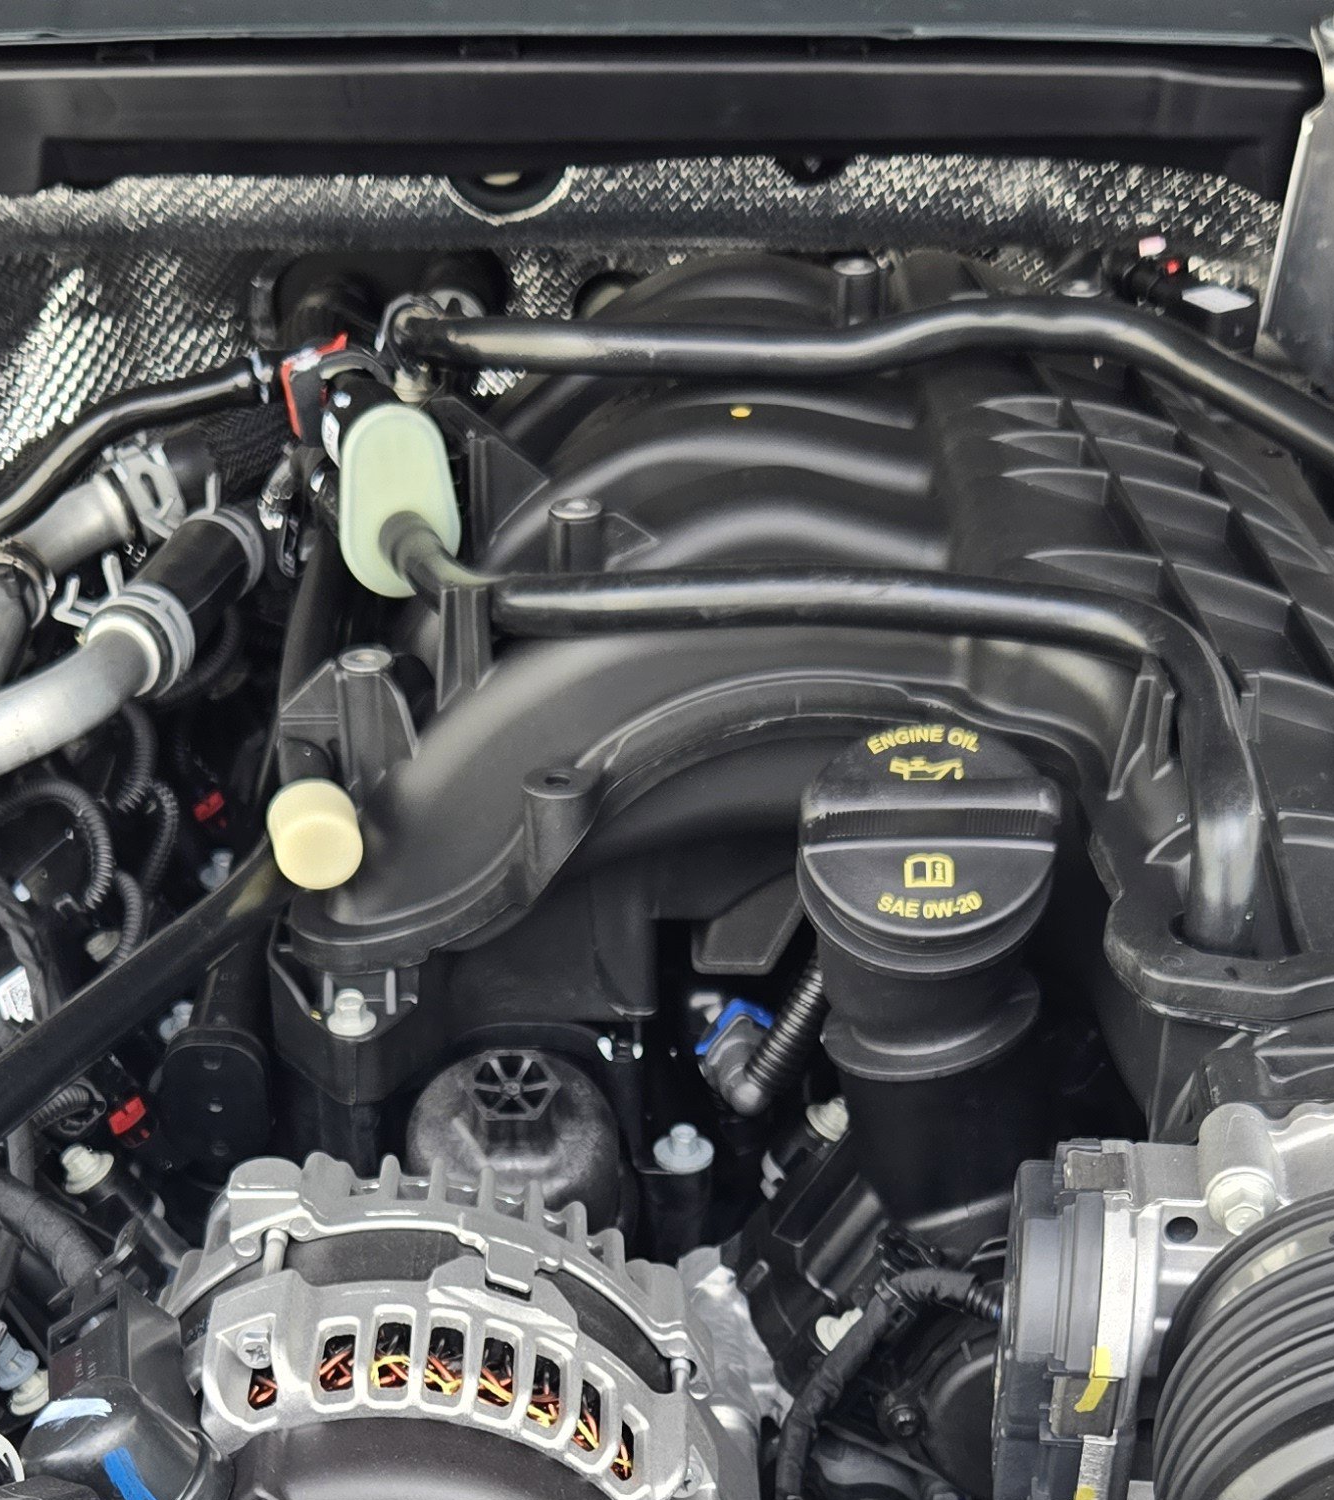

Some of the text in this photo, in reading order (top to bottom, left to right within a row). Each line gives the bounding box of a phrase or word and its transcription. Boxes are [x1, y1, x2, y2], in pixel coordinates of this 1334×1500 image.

[867, 726, 980, 755] ENGINE OIL
[877, 891, 982, 919] SAE 0W-20
